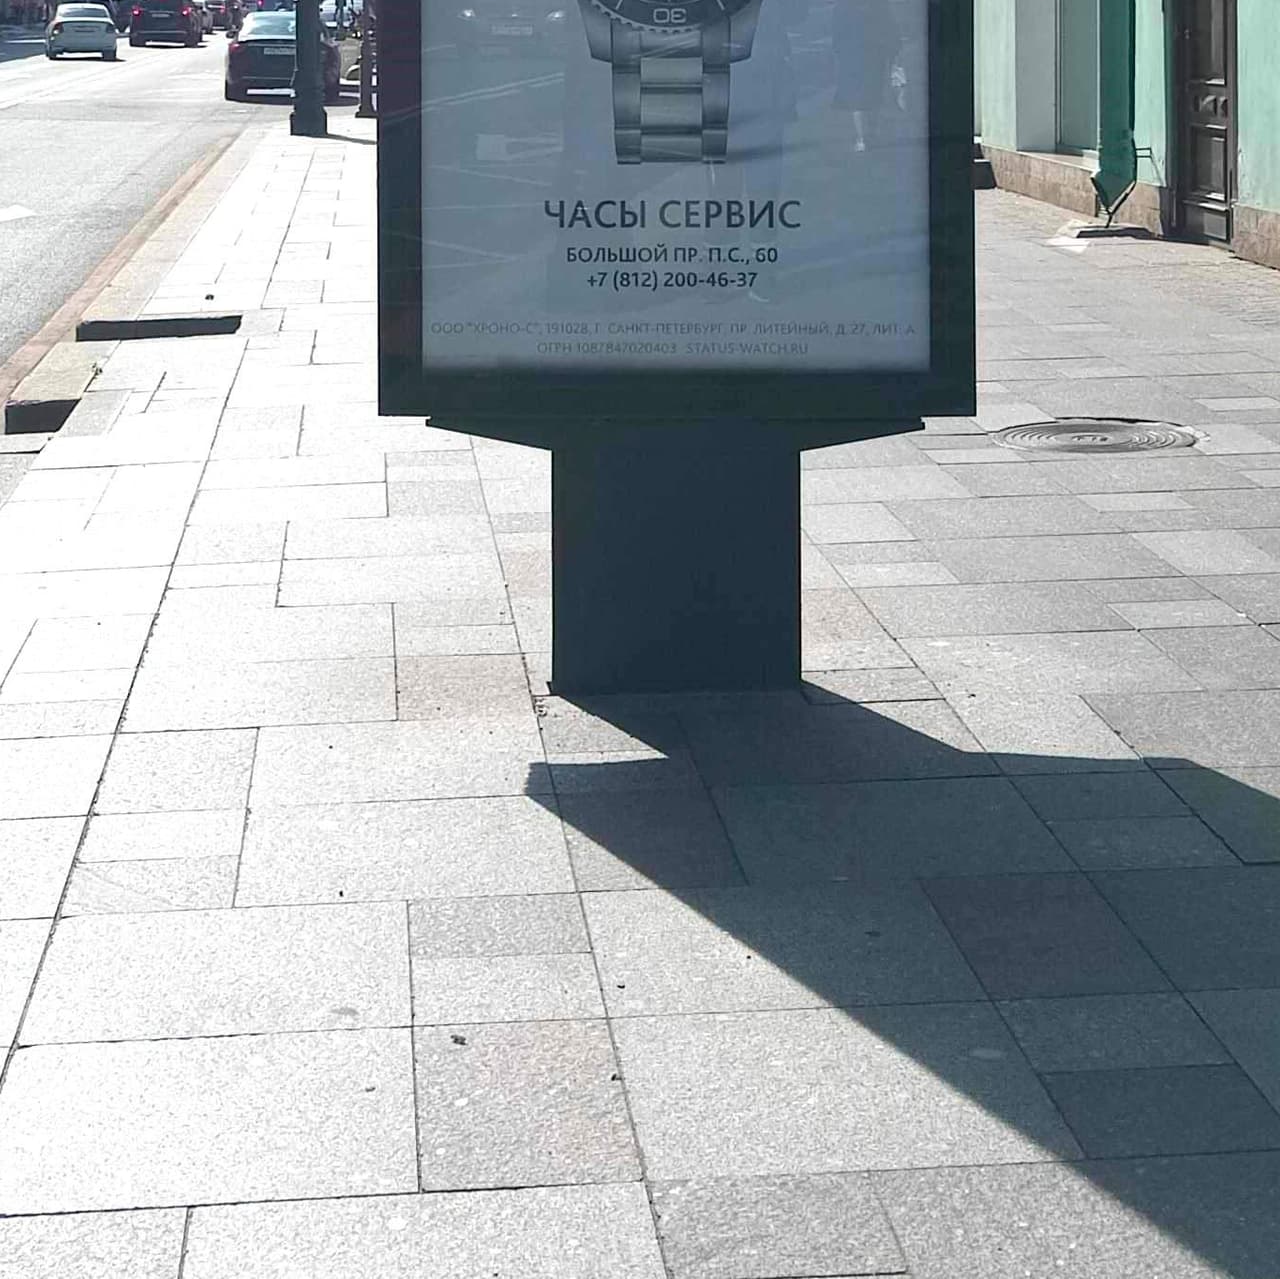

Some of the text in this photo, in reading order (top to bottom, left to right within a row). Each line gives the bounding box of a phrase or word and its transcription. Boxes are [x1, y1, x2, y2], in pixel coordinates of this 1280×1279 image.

[544, 199, 802, 229] ЧАСЫ СЕРВИС
[566, 243, 668, 263] БОЛЬШОЙ
[673, 247, 703, 263] ПР.
[755, 247, 778, 263] 60
[587, 271, 758, 292] +7 (812) 200-46-37
[431, 322, 464, 334] ООО
[537, 342, 572, 353] ОГРН
[687, 342, 808, 354] STATUS-WATCH.RU
